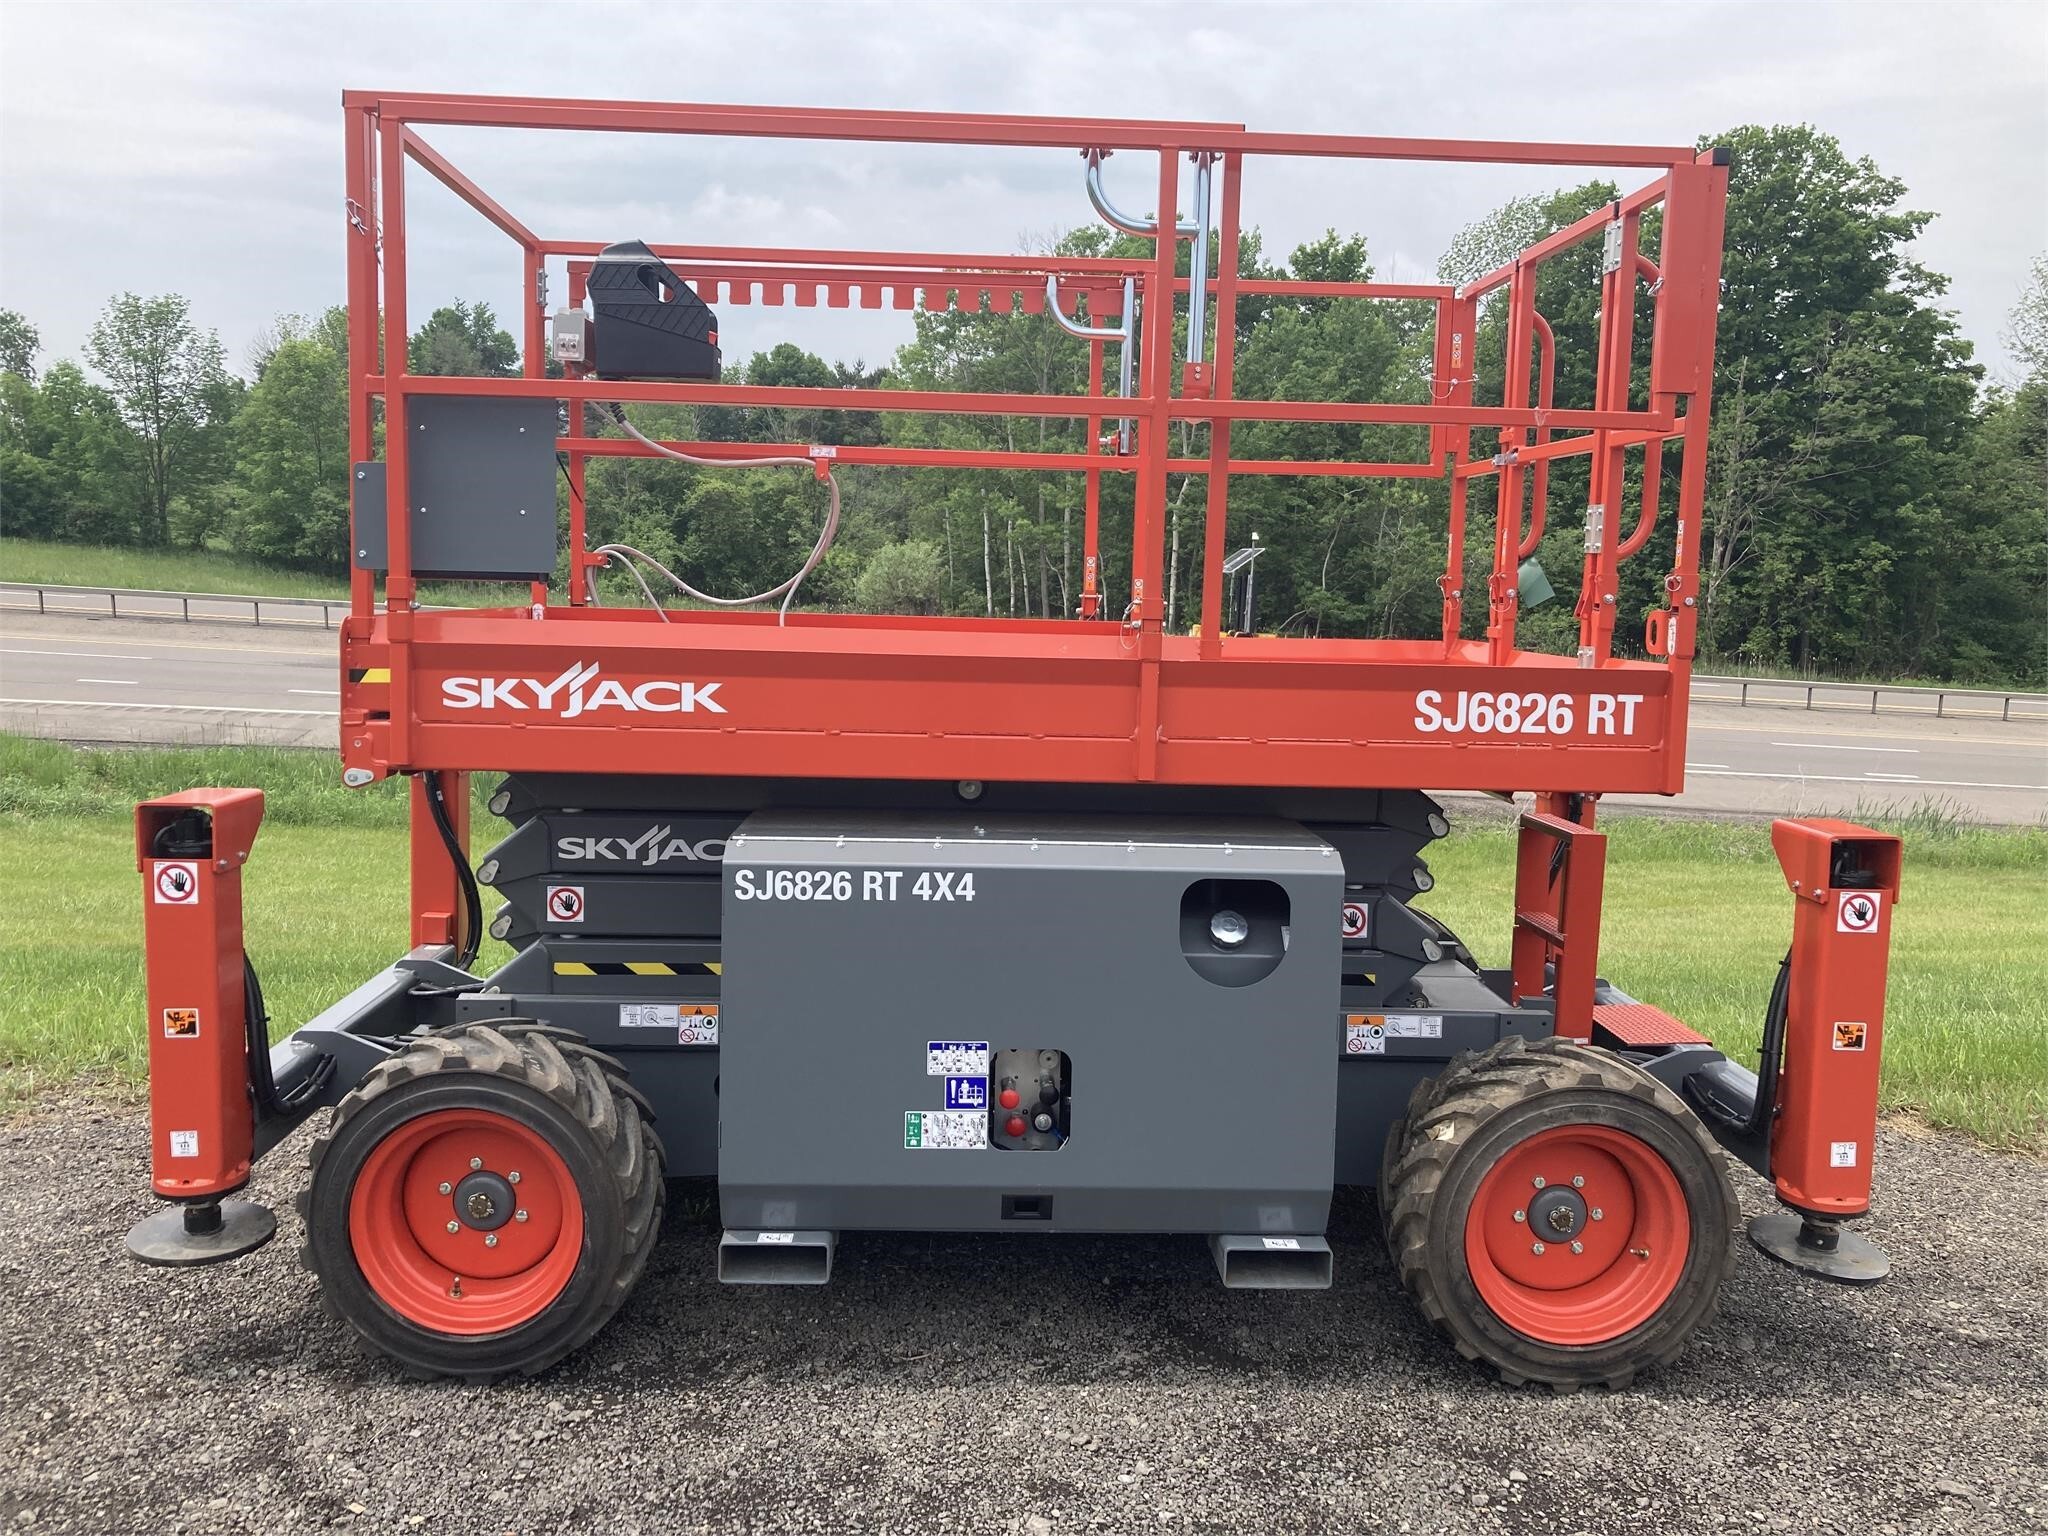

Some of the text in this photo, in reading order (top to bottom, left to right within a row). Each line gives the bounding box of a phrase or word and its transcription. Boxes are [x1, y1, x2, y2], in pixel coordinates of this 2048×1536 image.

[441, 660, 728, 718] SKYJACK
[1414, 690, 1644, 735] SJ6826 RT
[557, 824, 726, 866] SKYJAC
[734, 869, 976, 902] SJ6826 RT 4X4
